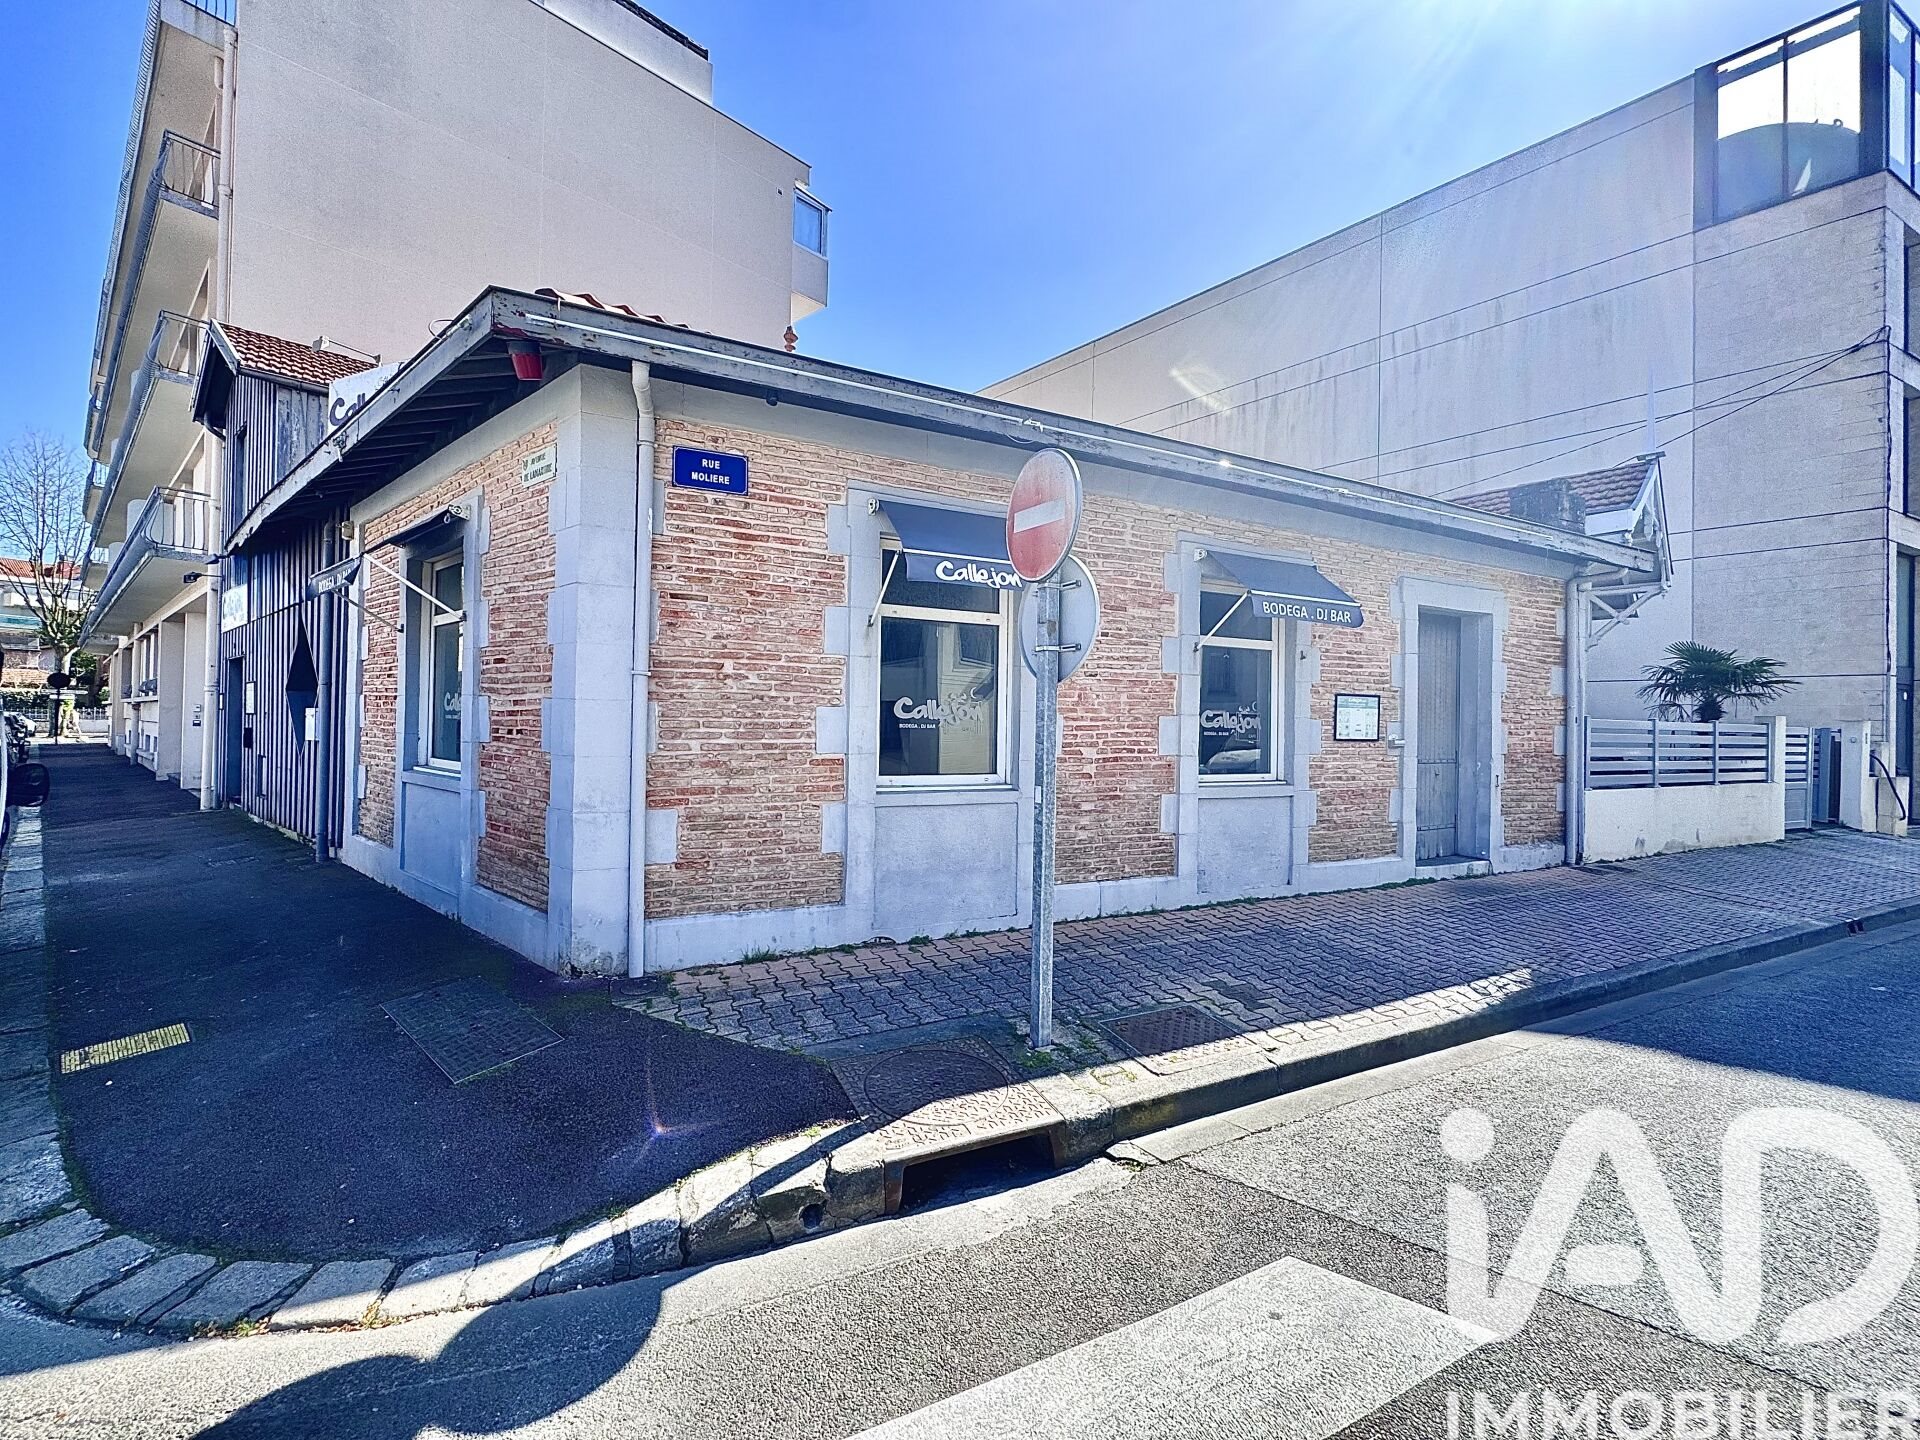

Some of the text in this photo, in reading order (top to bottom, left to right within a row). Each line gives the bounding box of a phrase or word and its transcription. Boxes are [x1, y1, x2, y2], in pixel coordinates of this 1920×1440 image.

[702, 459, 721, 470] RUE
[691, 471, 730, 485] MOLIERE
[935, 561, 1022, 589] Callejon
[1262, 601, 1309, 619] BODEGA
[1316, 608, 1328, 621] DJ
[1330, 609, 1352, 623] BAR
[893, 696, 984, 726] Callejon
[1200, 709, 1261, 734] Callejon
